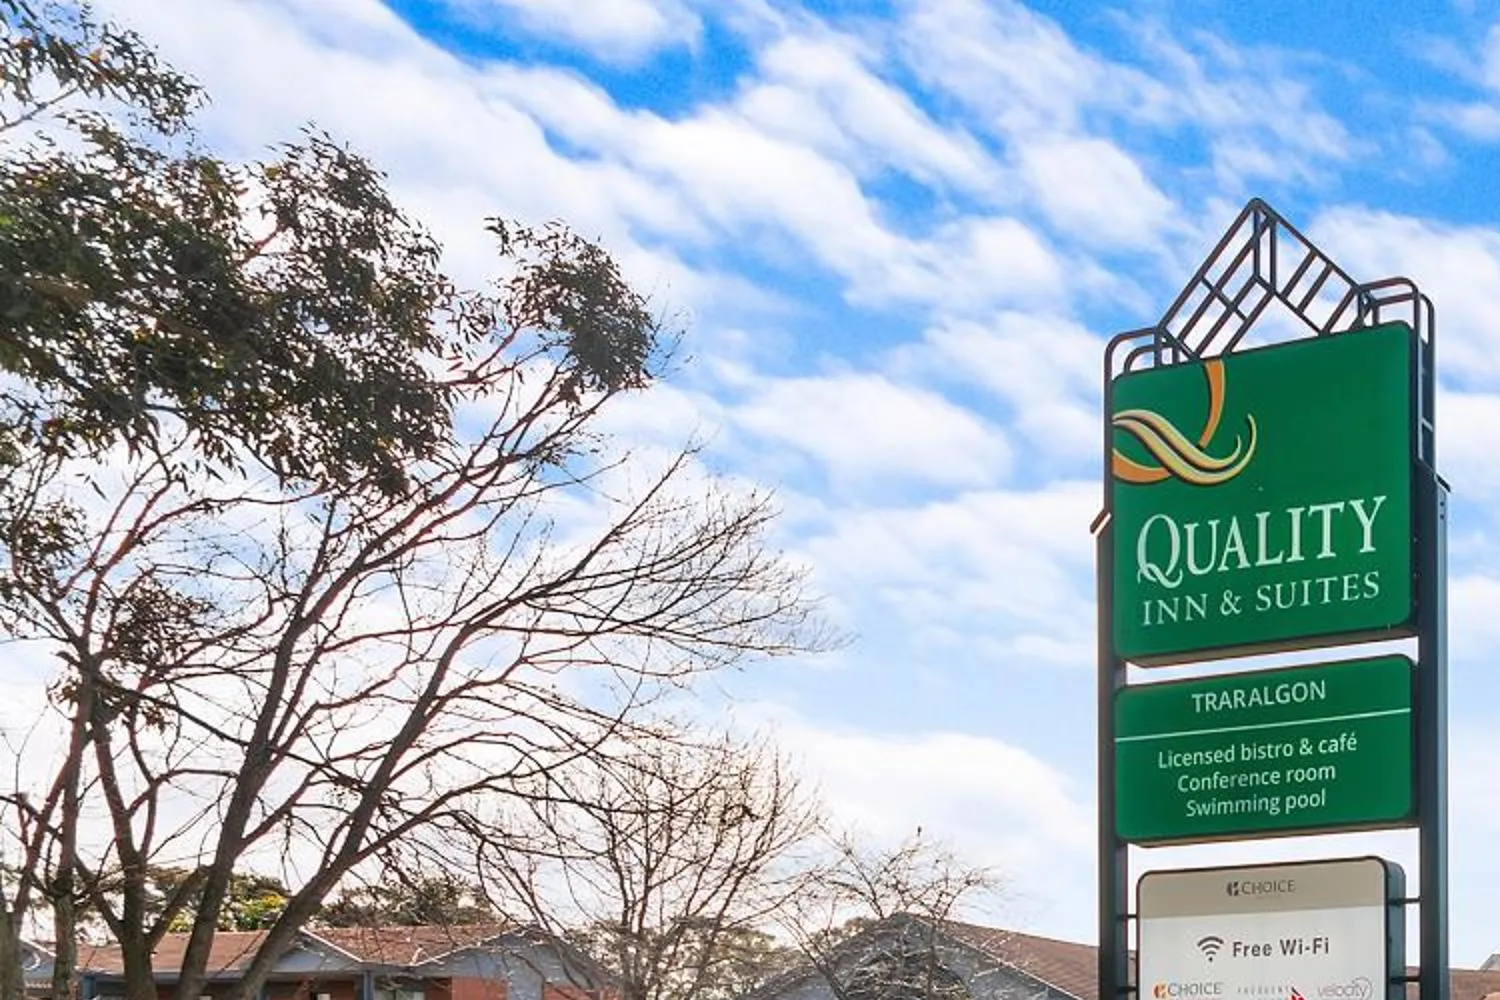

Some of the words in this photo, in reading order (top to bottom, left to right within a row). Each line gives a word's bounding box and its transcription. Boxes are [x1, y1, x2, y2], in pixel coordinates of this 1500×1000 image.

[1137, 496, 1386, 588] QUALITY
[1143, 594, 1206, 625] INN
[1220, 590, 1241, 615] &
[1255, 571, 1379, 611] SUITES
[1192, 680, 1326, 713] TRARALGON
[1158, 746, 1234, 769] Licensed
[1240, 741, 1293, 762] bistro
[1299, 738, 1313, 755] &
[1318, 732, 1357, 754] café
[1178, 771, 1280, 793] Conference
[1285, 764, 1336, 783] room
[1186, 794, 1280, 817] Swimming
[1285, 789, 1326, 813] pool
[1241, 880, 1296, 895] CHOICE
[1232, 941, 1272, 957] Free
[1279, 938, 1329, 956] Wi-Fi
[1167, 982, 1224, 997] CHOICE
